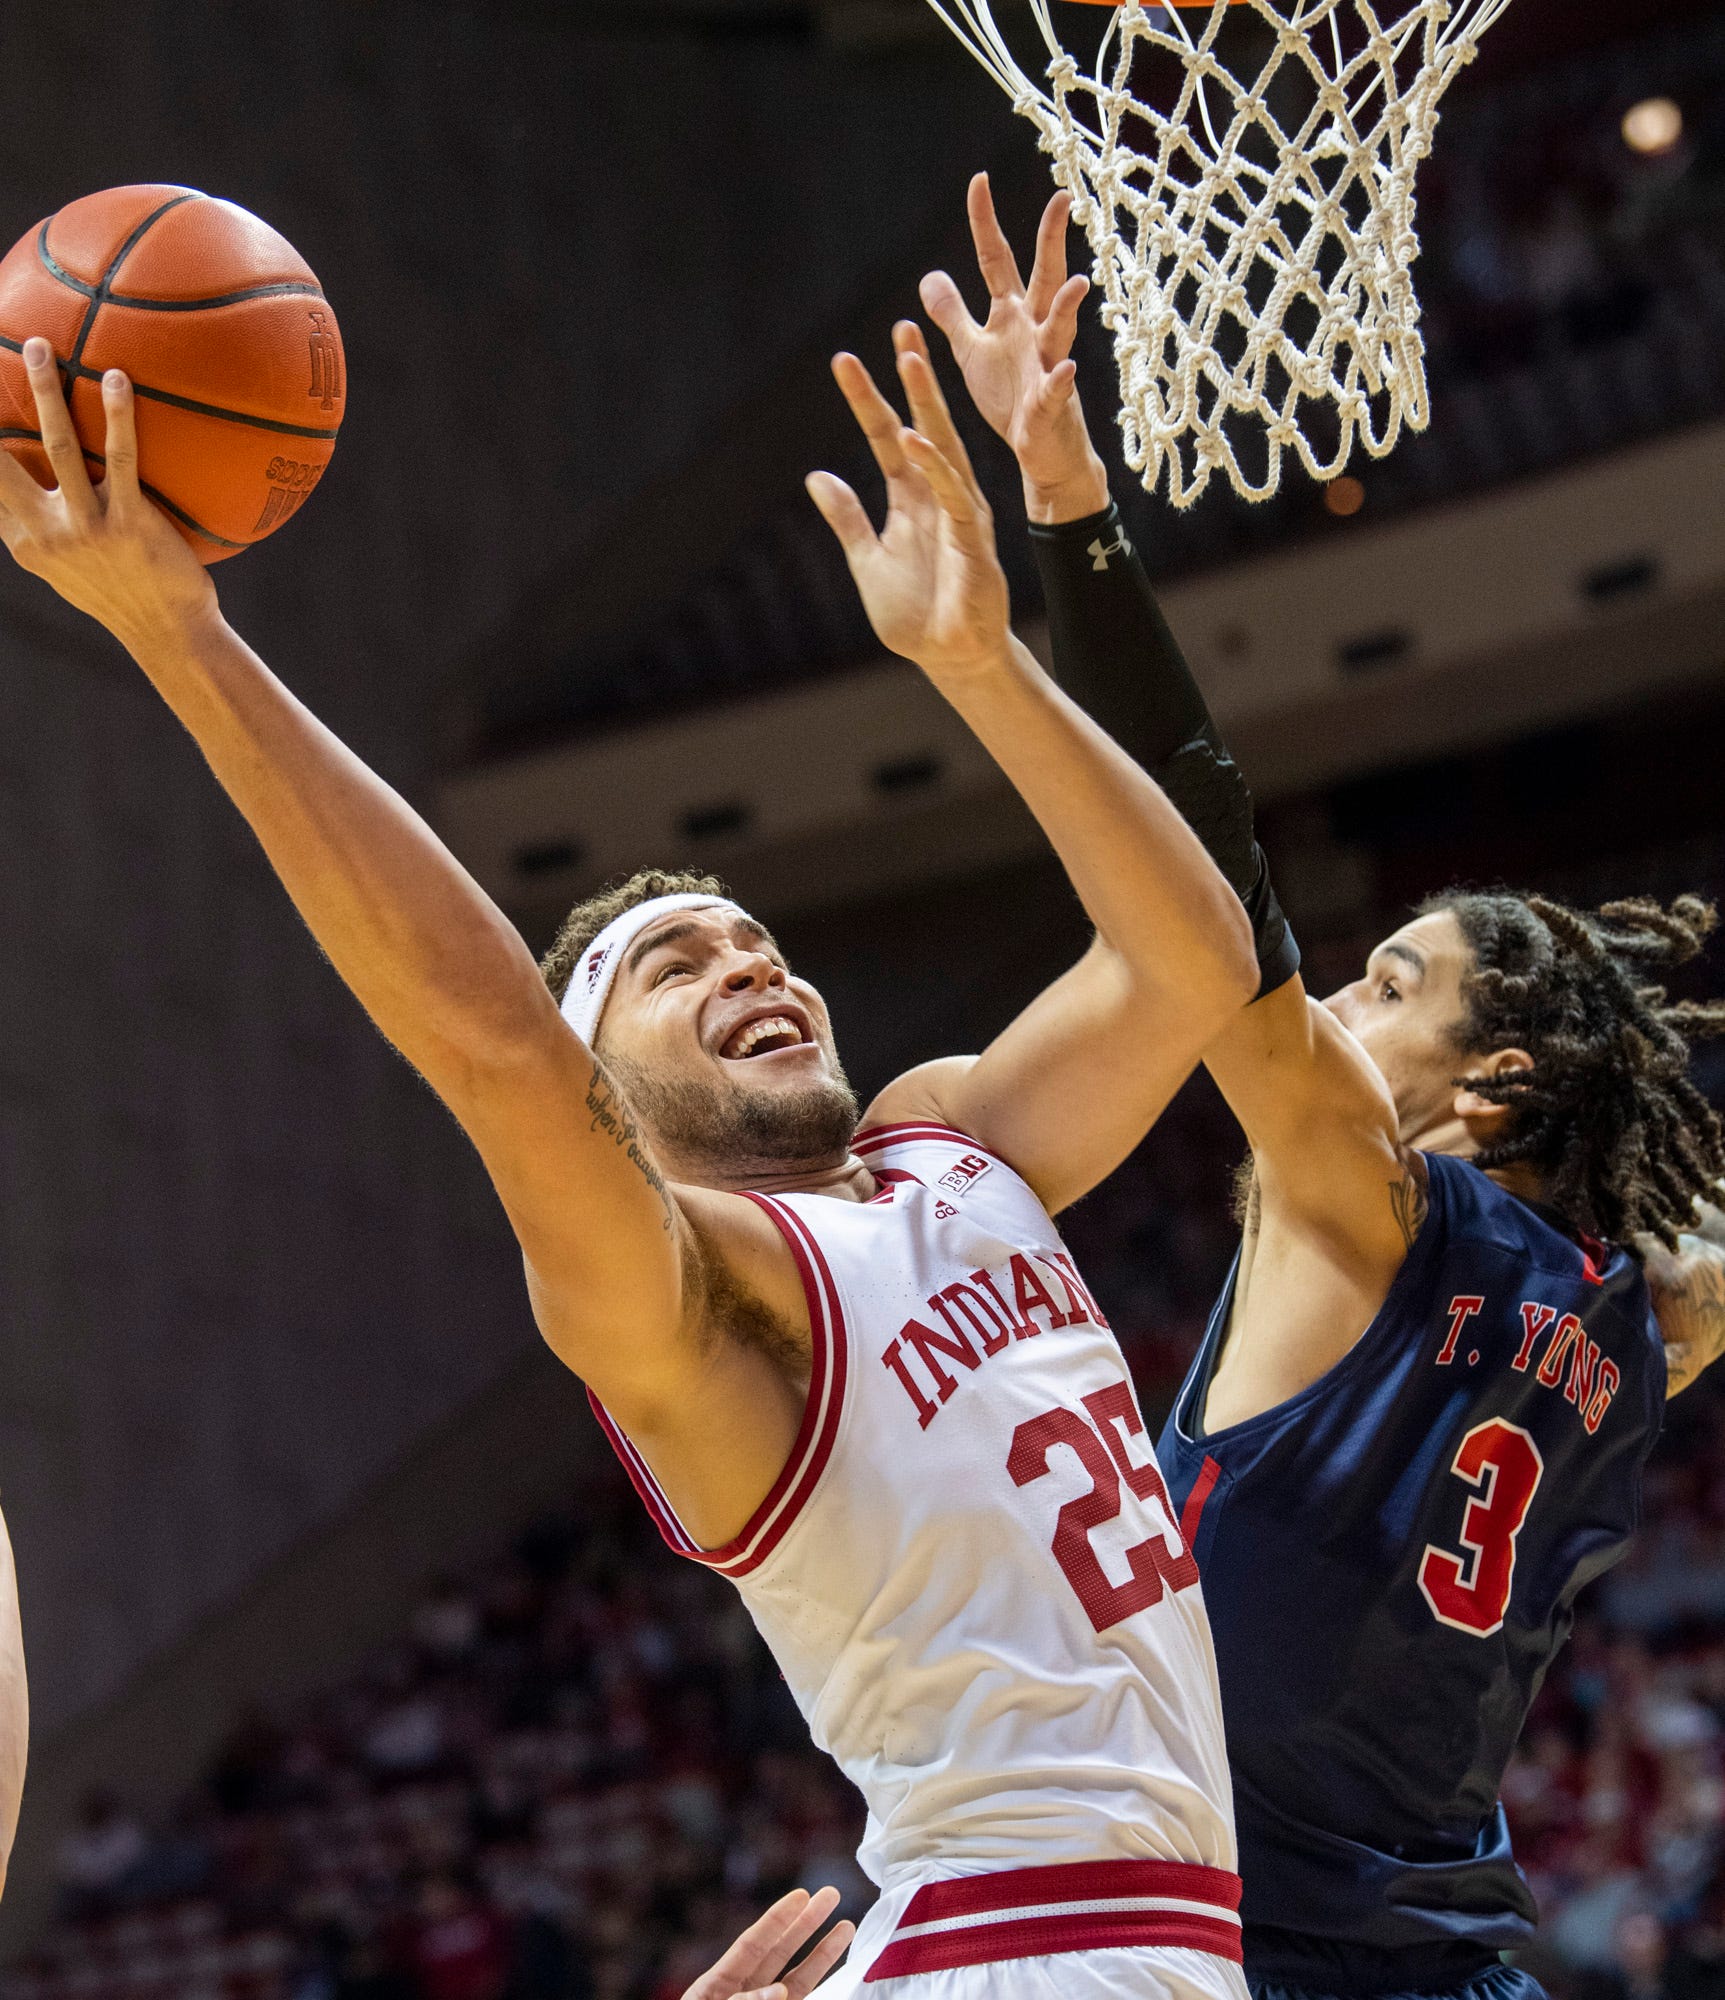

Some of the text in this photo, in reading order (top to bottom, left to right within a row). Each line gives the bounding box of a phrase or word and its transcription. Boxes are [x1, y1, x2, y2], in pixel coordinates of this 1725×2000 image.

[881, 1252, 1110, 1430] INDIAN
[1435, 1295, 1485, 1367] T.
[1005, 1379, 1200, 1634] 25
[1416, 1415, 1545, 1640] 3
